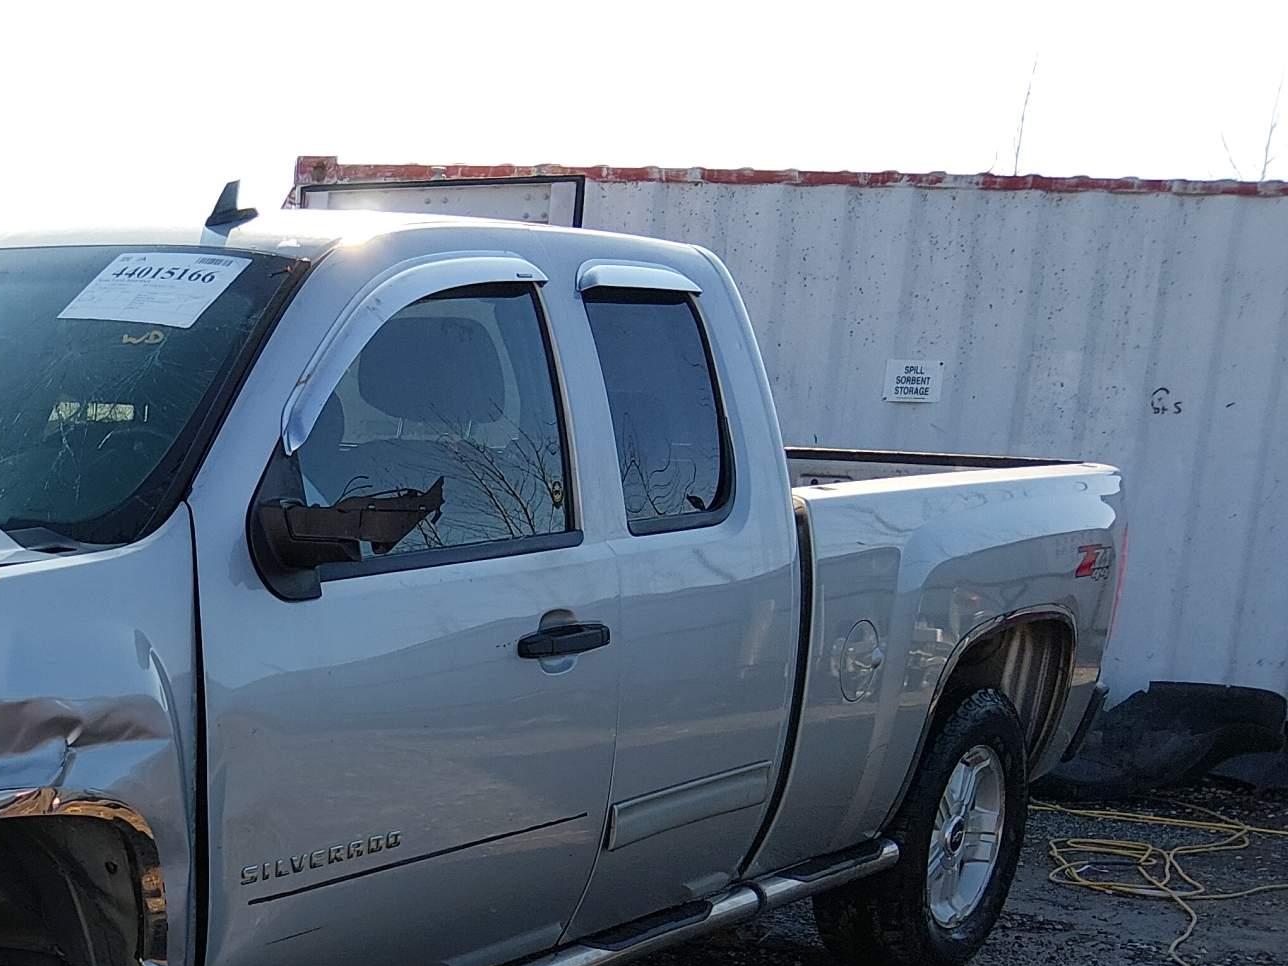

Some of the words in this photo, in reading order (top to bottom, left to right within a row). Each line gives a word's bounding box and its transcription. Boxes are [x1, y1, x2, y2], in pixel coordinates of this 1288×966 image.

[112, 265, 217, 284] 44015166
[904, 365, 925, 375] SPILL
[895, 375, 931, 385] SORBENT
[894, 386, 930, 396] STORAGE
[240, 830, 401, 886] SILVERADO
